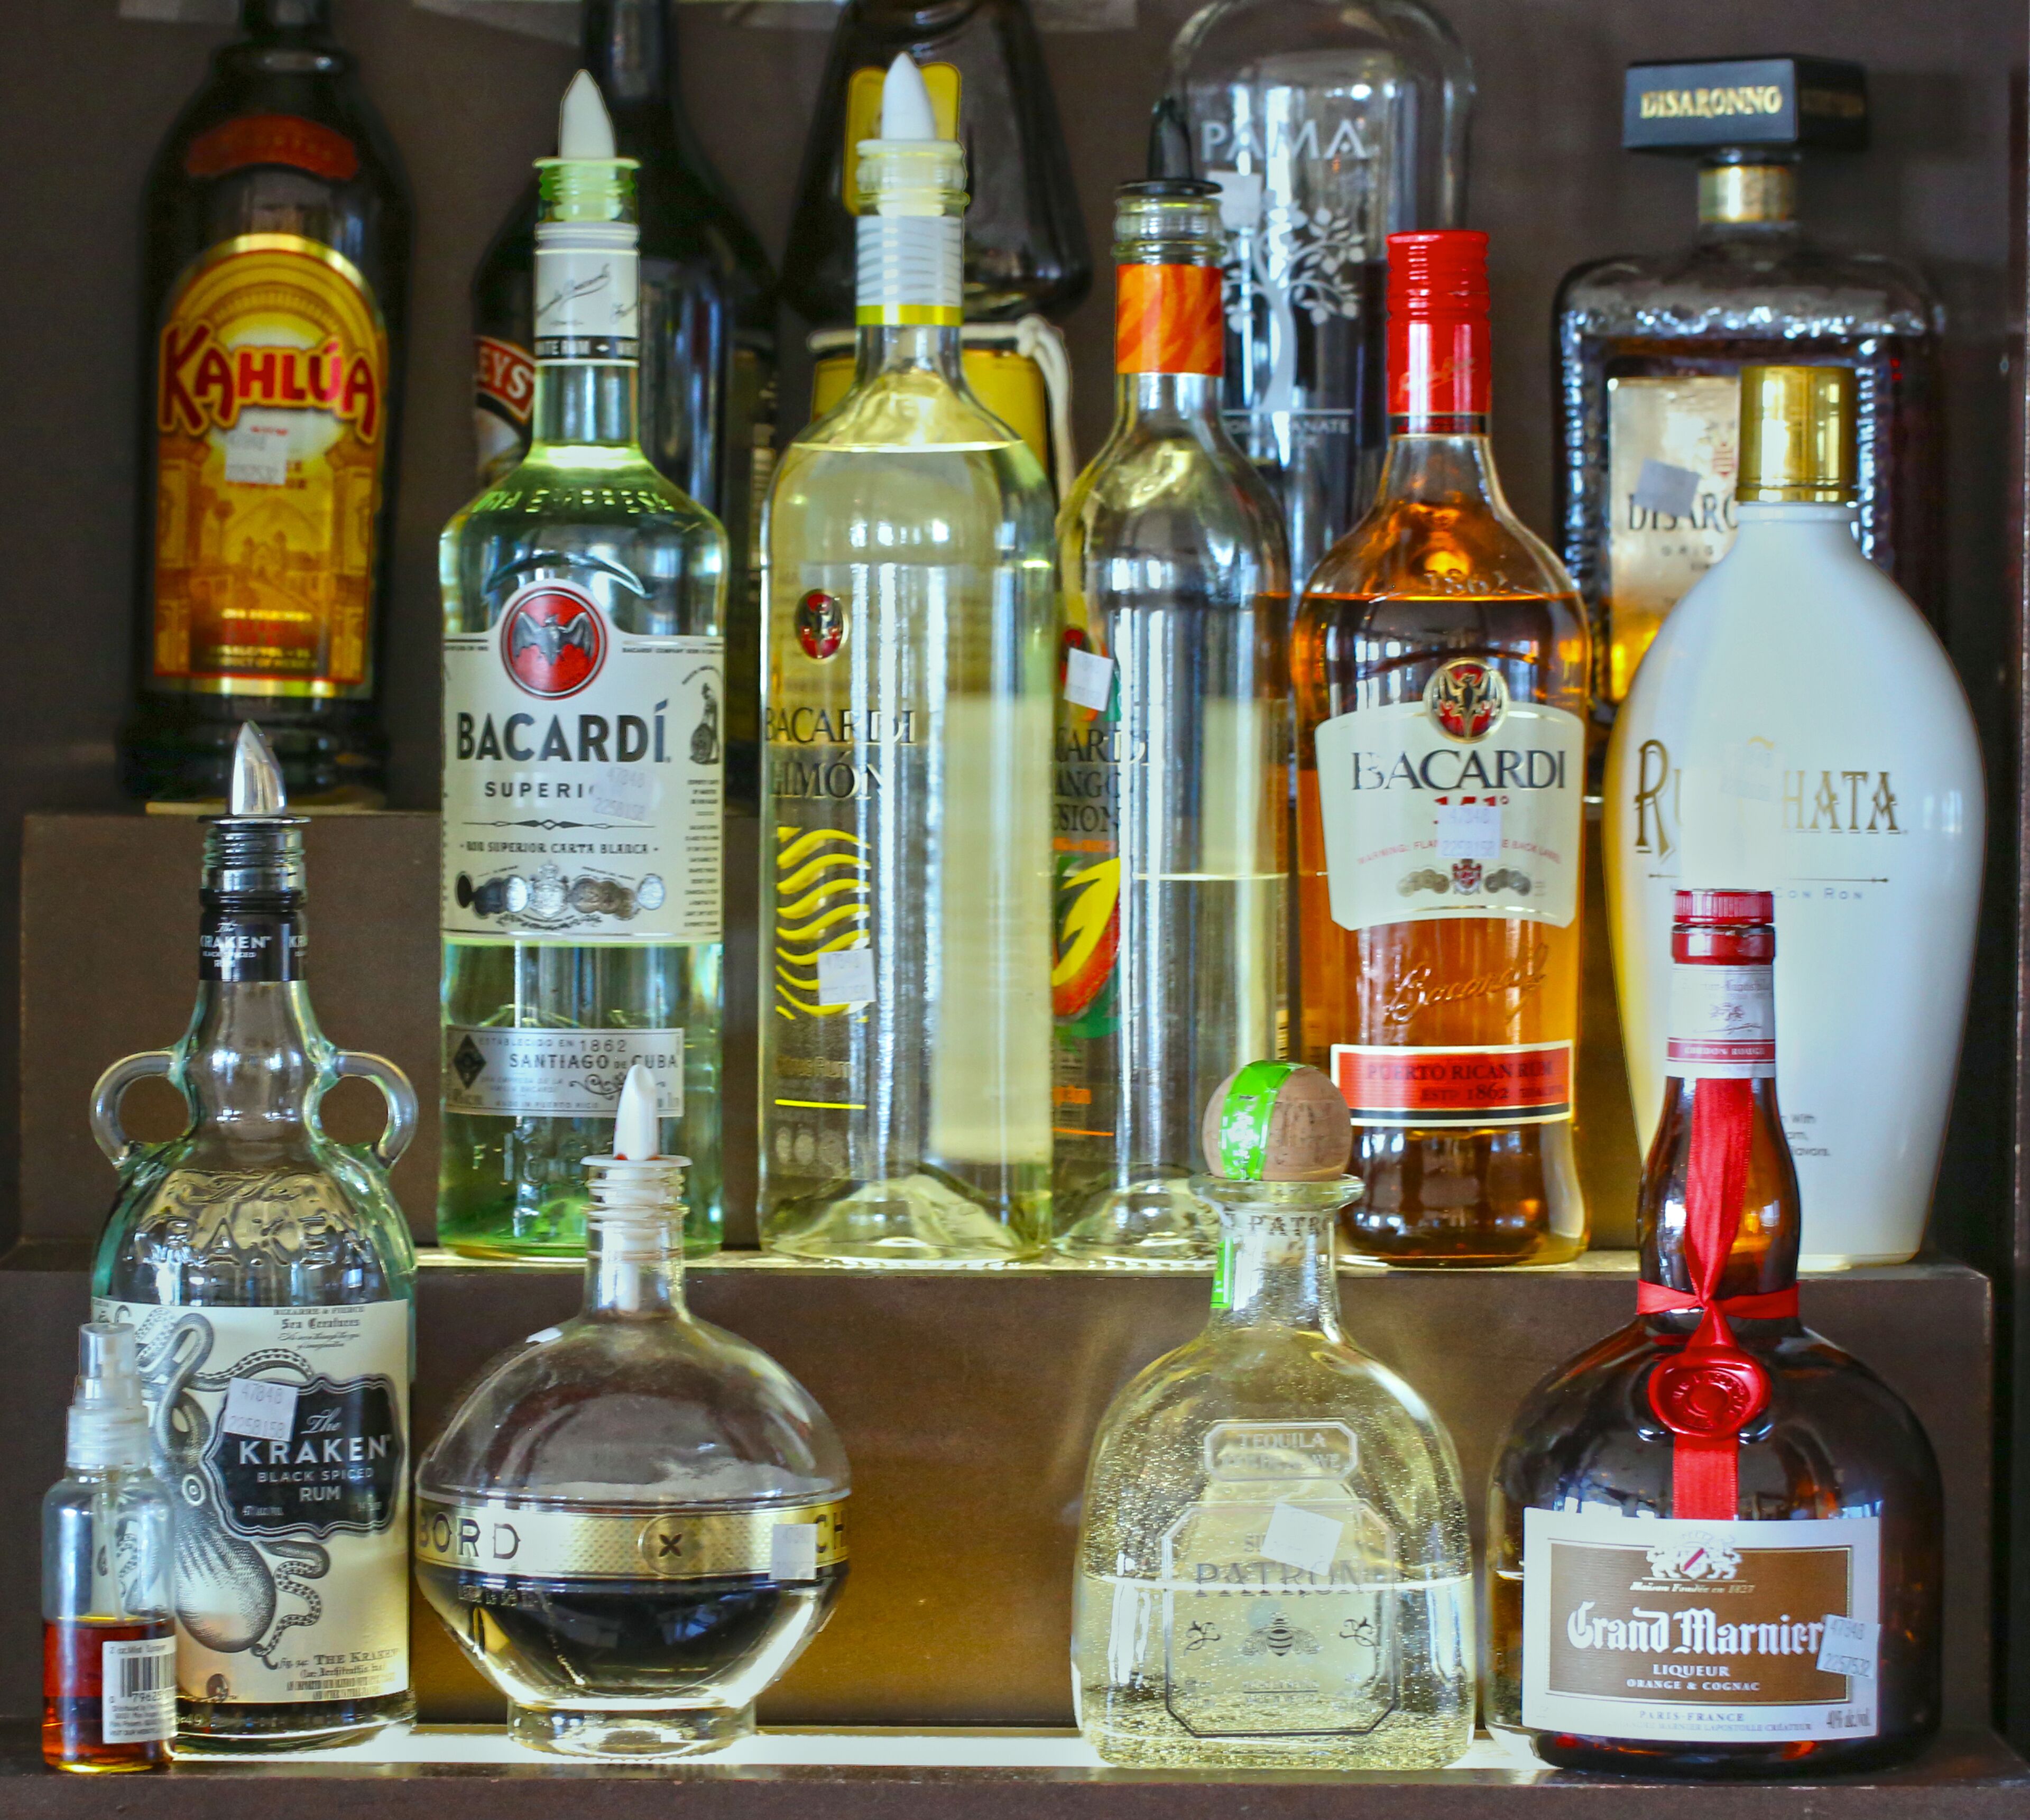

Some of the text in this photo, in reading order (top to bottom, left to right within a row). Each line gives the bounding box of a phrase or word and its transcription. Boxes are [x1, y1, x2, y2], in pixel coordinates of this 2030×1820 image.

[1639, 86, 1783, 119] DISARONNO
[1201, 119, 1368, 160] PAMA
[160, 321, 380, 441] KAHLÚA
[457, 699, 668, 763] BACARDÍ
[1351, 749, 1566, 791] BACARDI
[484, 781, 594, 798] SUPERI
[478, 1038, 553, 1047] ESTABLECDO
[580, 1039, 626, 1052] 1862
[509, 1054, 609, 1069] SANTIAGO
[631, 1055, 679, 1069] CUBA
[1368, 1064, 1447, 1080] PUERTO
[1451, 1063, 1514, 1079] RICAN
[1465, 1083, 1510, 1100] 1862
[300, 1407, 343, 1434] The
[1239, 1432, 1326, 1449] TEQUILA
[239, 1434, 387, 1465] KRAKEN
[256, 1467, 374, 1483] BLACK SPICED
[299, 1486, 343, 1502] RUM
[1567, 1601, 1823, 1656] Grand Marnier
[313, 1653, 346, 1665] THE
[349, 1649, 399, 1662] KRAKEN
[1653, 1664, 1730, 1678] LIQUEUR
[1627, 1678, 1760, 1692] ORANGE & COGNAC
